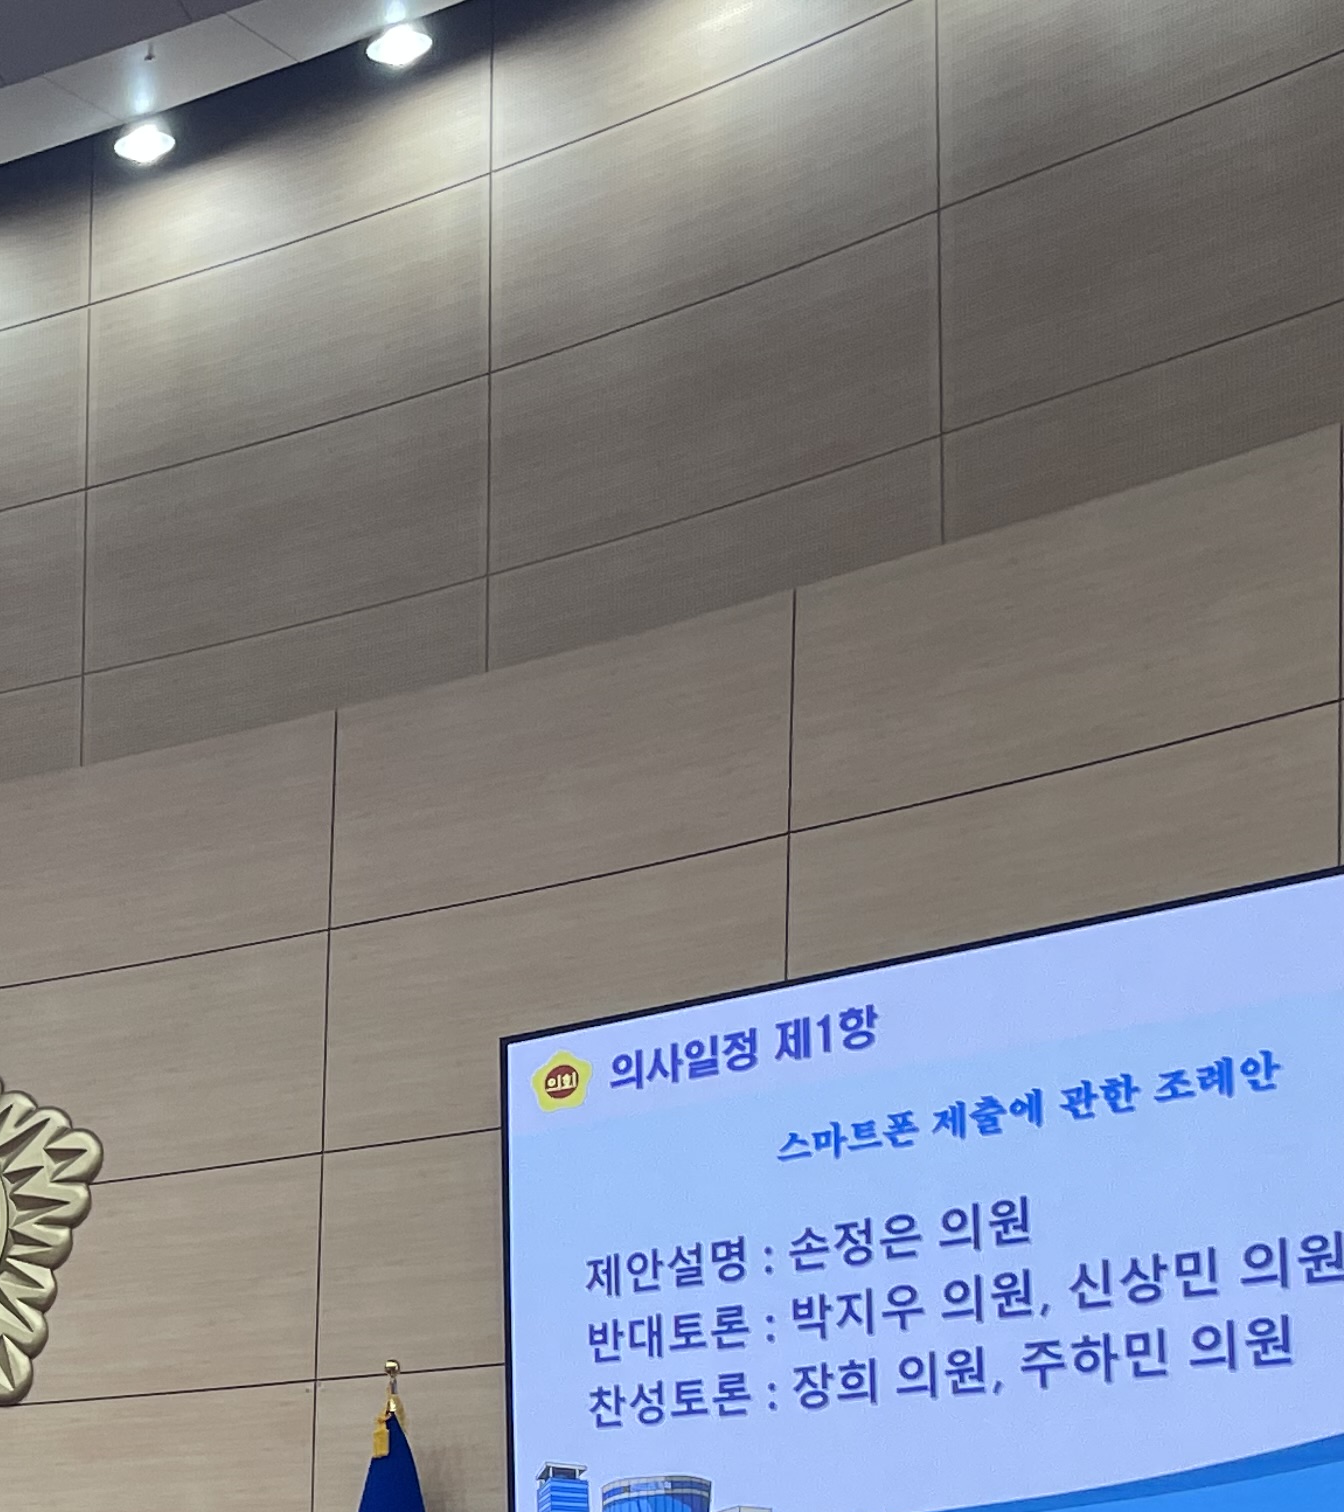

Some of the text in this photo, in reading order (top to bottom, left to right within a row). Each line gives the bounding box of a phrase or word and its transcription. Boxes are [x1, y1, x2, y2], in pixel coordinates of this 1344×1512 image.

[610, 1004, 878, 1090] 의사일정 제1항
[777, 1049, 1282, 1162] 스마트폰 제출에 관한 조례안
[585, 1235, 746, 1297] 제안설명
[788, 1213, 922, 1272] 손정은
[939, 1195, 1031, 1251] 의원
[587, 1304, 750, 1364] 반대토론
[791, 1284, 924, 1340] 박지우
[941, 1268, 1050, 1323] 의원,
[1069, 1246, 1219, 1310] 신상민
[1240, 1230, 1344, 1288] 의원
[589, 1371, 753, 1429] 찬성토론
[793, 1357, 878, 1411] 장희
[896, 1345, 1003, 1399] 의원,
[1020, 1327, 1168, 1390] 주하민
[1189, 1314, 1294, 1372] 의원
